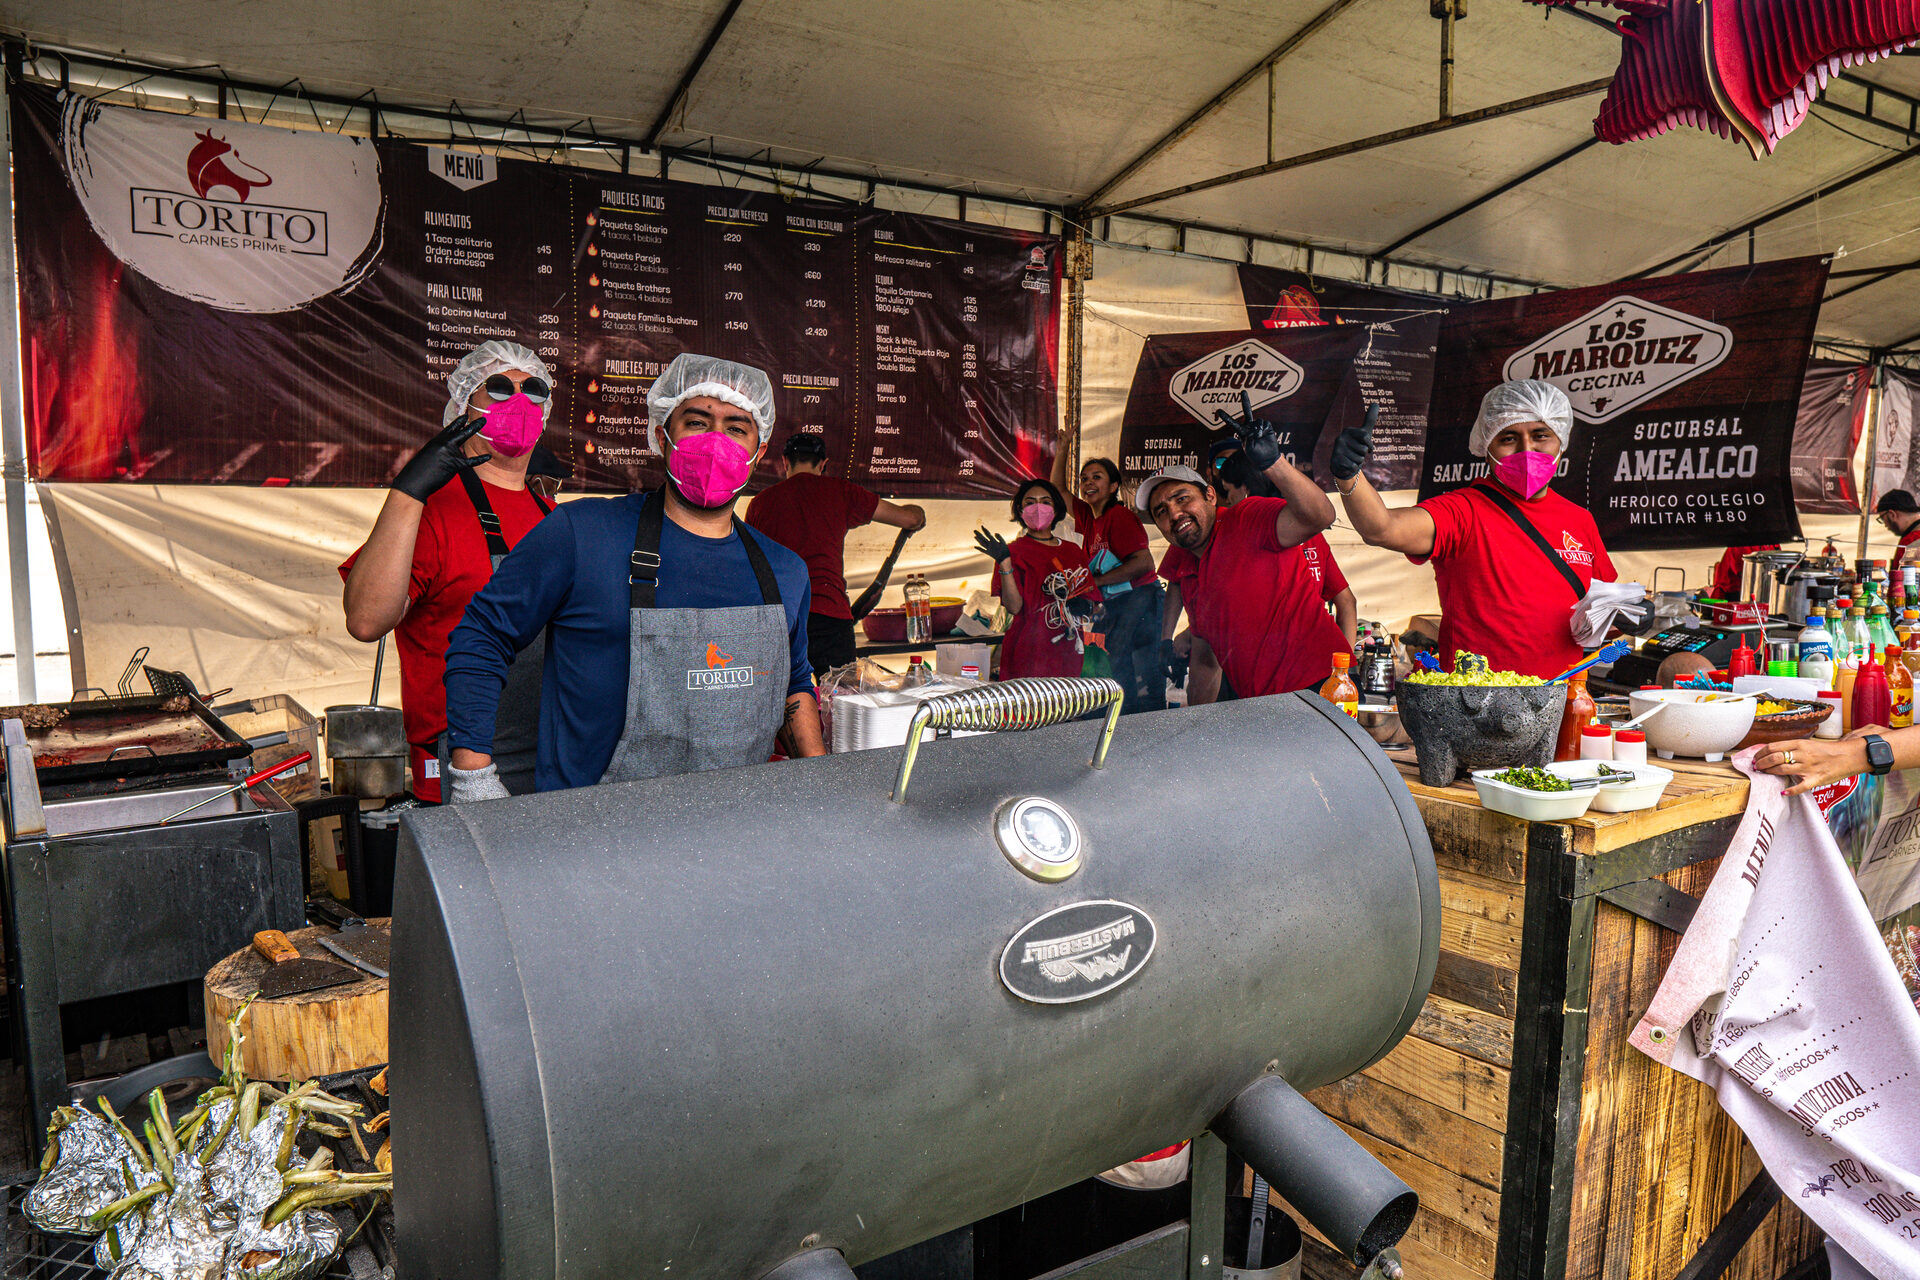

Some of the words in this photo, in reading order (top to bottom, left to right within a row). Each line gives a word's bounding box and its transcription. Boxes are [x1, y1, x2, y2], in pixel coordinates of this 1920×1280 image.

[444, 154, 484, 181] MENÚ
[601, 190, 640, 207] PAQUETES
[642, 194, 665, 210] TACOS
[142, 195, 316, 244] TORITO
[424, 210, 472, 230] ALIMENTOS
[707, 205, 727, 217] PRECIO
[728, 208, 740, 218] CON
[740, 210, 768, 222] REFRESCO
[600, 219, 632, 232] Paquete
[786, 216, 804, 226] PRECIO
[178, 232, 239, 249] CARNES
[242, 239, 287, 254] PRIME
[432, 234, 452, 244] Taco
[454, 235, 492, 248] solitario
[724, 234, 742, 242] $220
[425, 245, 452, 257] Orden
[453, 248, 465, 258] de
[467, 250, 494, 262] papas
[537, 245, 552, 254] $45
[804, 243, 820, 252] $330
[434, 255, 443, 264] la
[445, 256, 486, 268] francesa
[600, 250, 634, 262] Paquete
[635, 252, 660, 265] Pareja
[874, 254, 904, 266] Refresco
[905, 258, 931, 268] solitario
[538, 265, 552, 275] $80
[633, 264, 639, 272] 2
[724, 263, 742, 271] $440
[602, 279, 635, 292] Paquete
[636, 282, 670, 294] Brothers
[875, 274, 893, 285] TEQUILA
[427, 283, 450, 299] PARA
[452, 285, 483, 302] LLEVAR
[725, 292, 743, 301] $770
[875, 294, 886, 303] Don
[887, 296, 903, 305] Julio
[904, 298, 914, 306] 70
[442, 306, 472, 318] Cecina
[474, 309, 507, 321] Natural
[875, 304, 891, 312] 1800
[538, 314, 559, 324] $250
[603, 310, 636, 323] Paquete
[638, 313, 665, 323] Familia
[442, 322, 472, 334] Cecina
[474, 325, 516, 337] Enchilada
[539, 331, 559, 340] $220
[1586, 318, 1646, 345] LOS
[538, 347, 559, 356] $200
[876, 344, 886, 352] Red
[887, 345, 907, 354] Label
[1220, 353, 1258, 370] LOS
[1529, 334, 1704, 380] MARQUEZ
[605, 360, 643, 375] PAQUETES
[645, 362, 659, 376] POR
[782, 373, 800, 384] PRECIO
[1182, 370, 1288, 394] MARQUEZ
[1568, 371, 1646, 392] CECINA
[602, 384, 635, 394] Paquete
[602, 394, 620, 402] 0.50
[803, 394, 820, 404] $770
[599, 415, 632, 425] Paquete
[875, 426, 900, 435] Absolut
[1634, 418, 1742, 441] SUCURSAL
[598, 446, 630, 456] Paquete
[1144, 439, 1182, 450] SUCURSAL
[1125, 456, 1141, 471] SAN
[1142, 456, 1165, 470] JUAN
[1184, 451, 1198, 470] RÍO
[1614, 445, 1759, 482] AMEALCO
[1433, 464, 1463, 482] SAN
[1609, 496, 1677, 508] HEROICO
[1686, 492, 1765, 507] COLEGIO
[1630, 511, 1696, 524] MILITAR
[1704, 510, 1747, 523] #180
[692, 670, 749, 685] TORITO
[1741, 809, 1775, 890] MENÚ
[1021, 920, 1135, 964] MASTERBUILT
